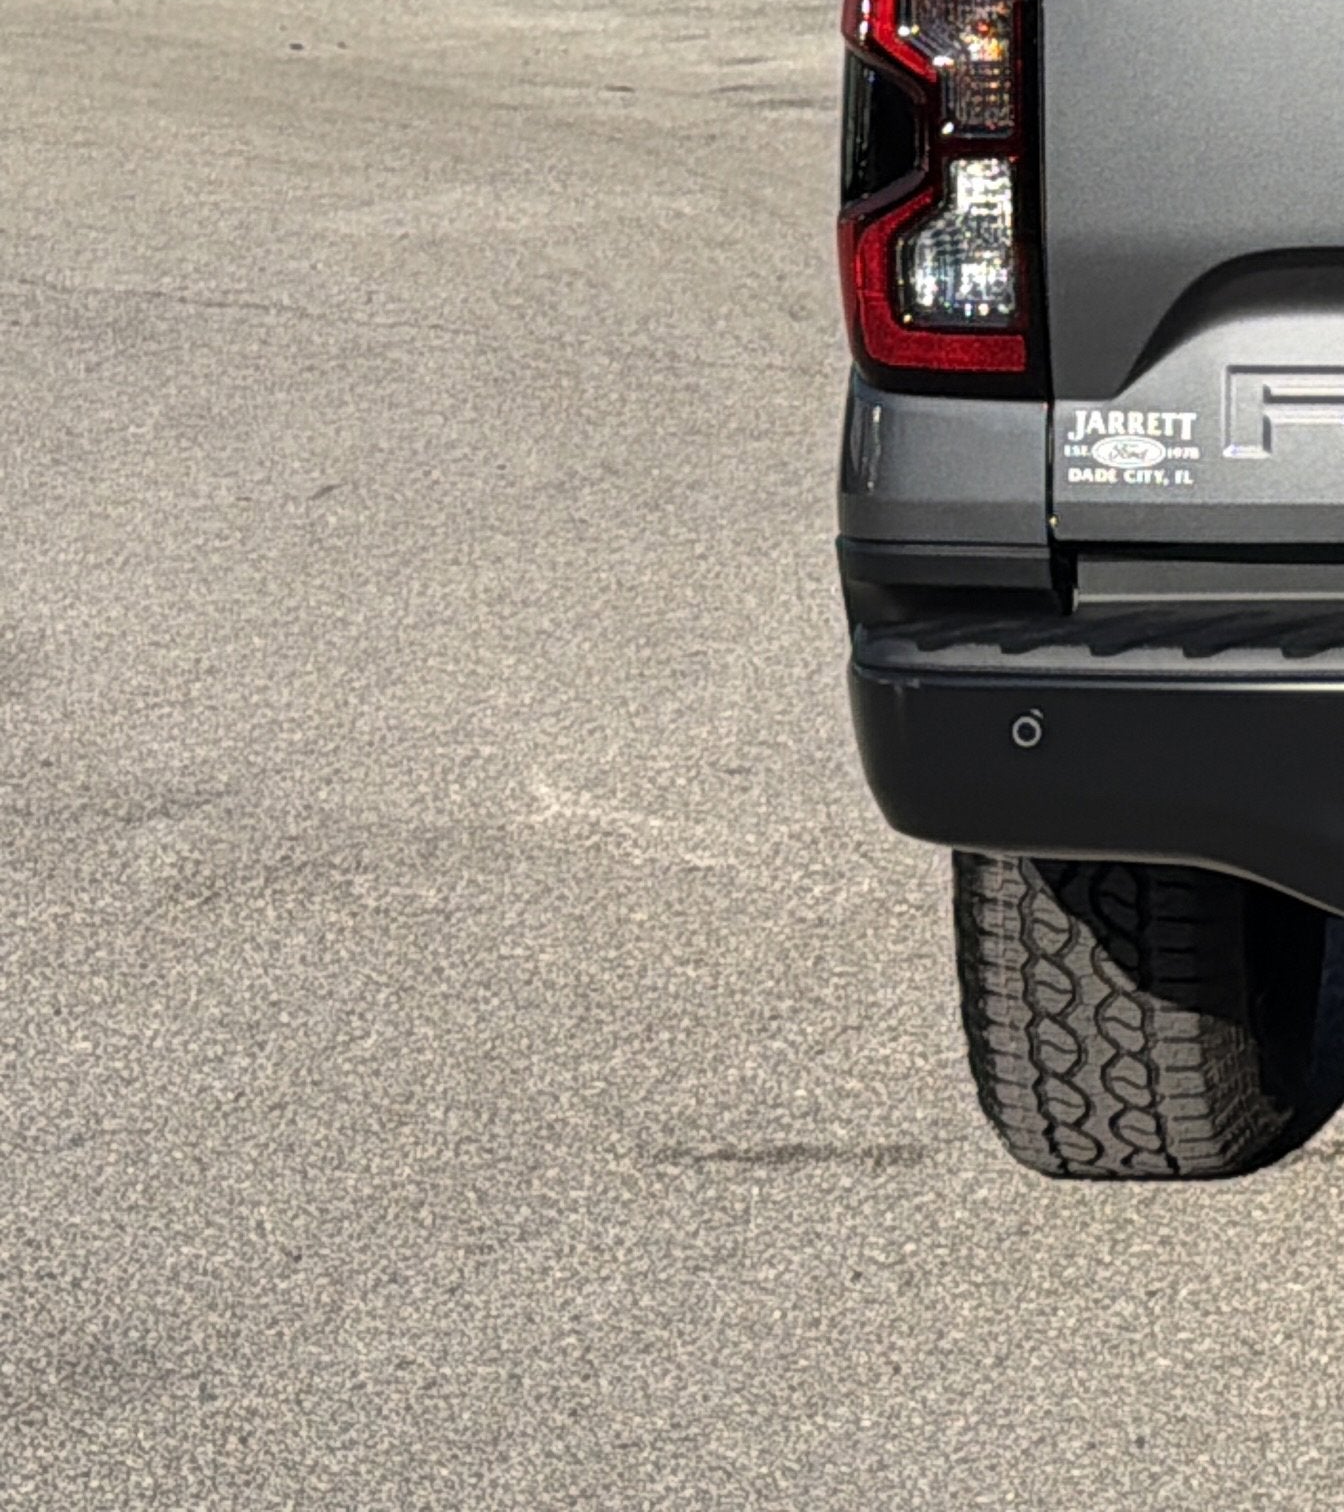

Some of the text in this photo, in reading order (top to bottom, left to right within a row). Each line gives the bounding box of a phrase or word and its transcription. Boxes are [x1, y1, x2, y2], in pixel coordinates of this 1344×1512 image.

[1067, 410, 1197, 441] JARRETT
[1068, 468, 1194, 486] DADE CITY, FL
